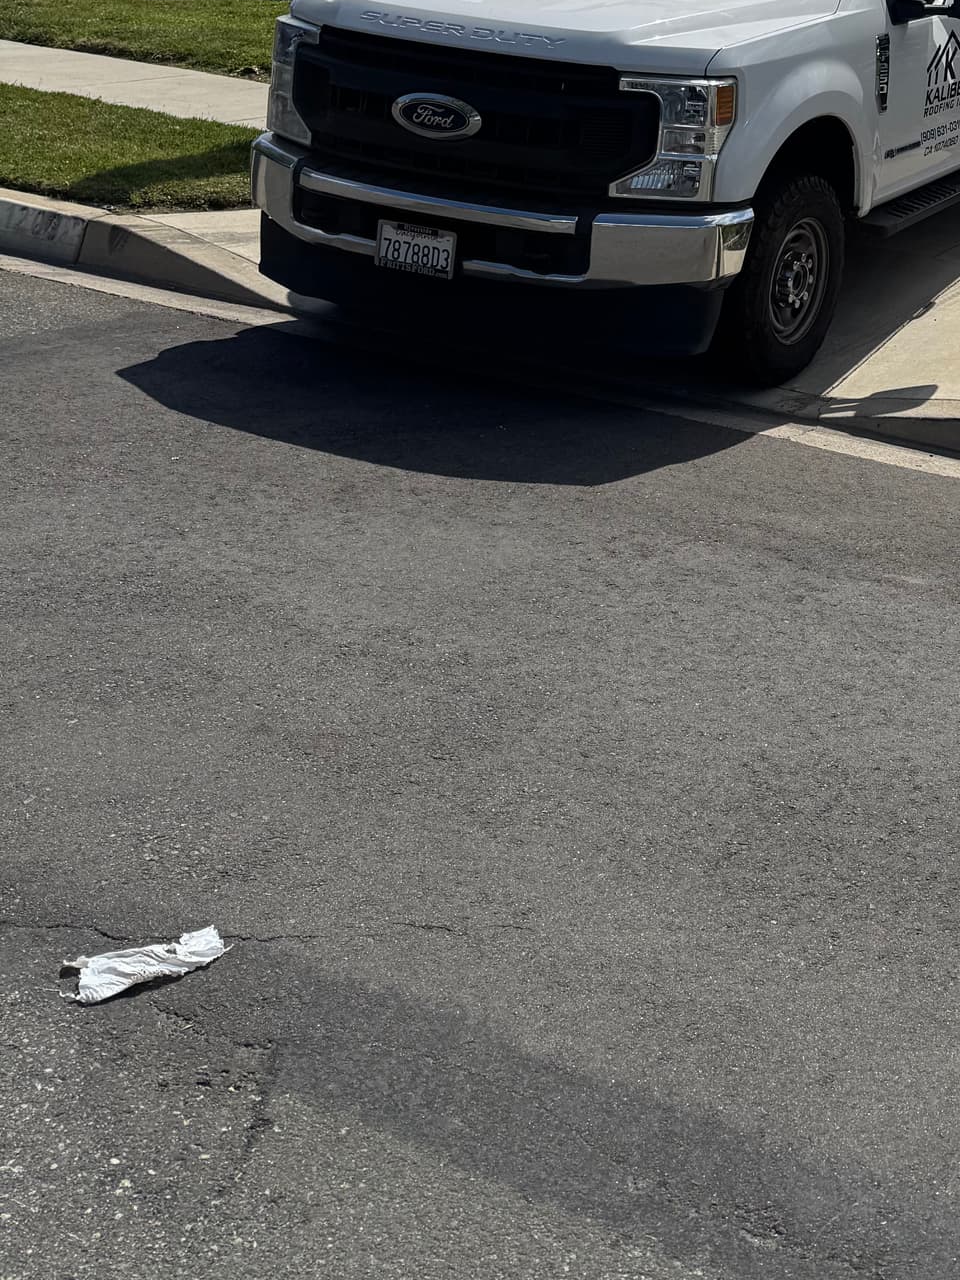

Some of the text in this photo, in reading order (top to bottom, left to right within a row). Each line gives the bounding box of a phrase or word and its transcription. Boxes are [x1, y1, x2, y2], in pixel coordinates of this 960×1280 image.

[359, 10, 567, 49] SUPER DUTY
[412, 104, 455, 129] Ford
[923, 100, 955, 118] ROOFING
[383, 237, 450, 270] 78788D3
